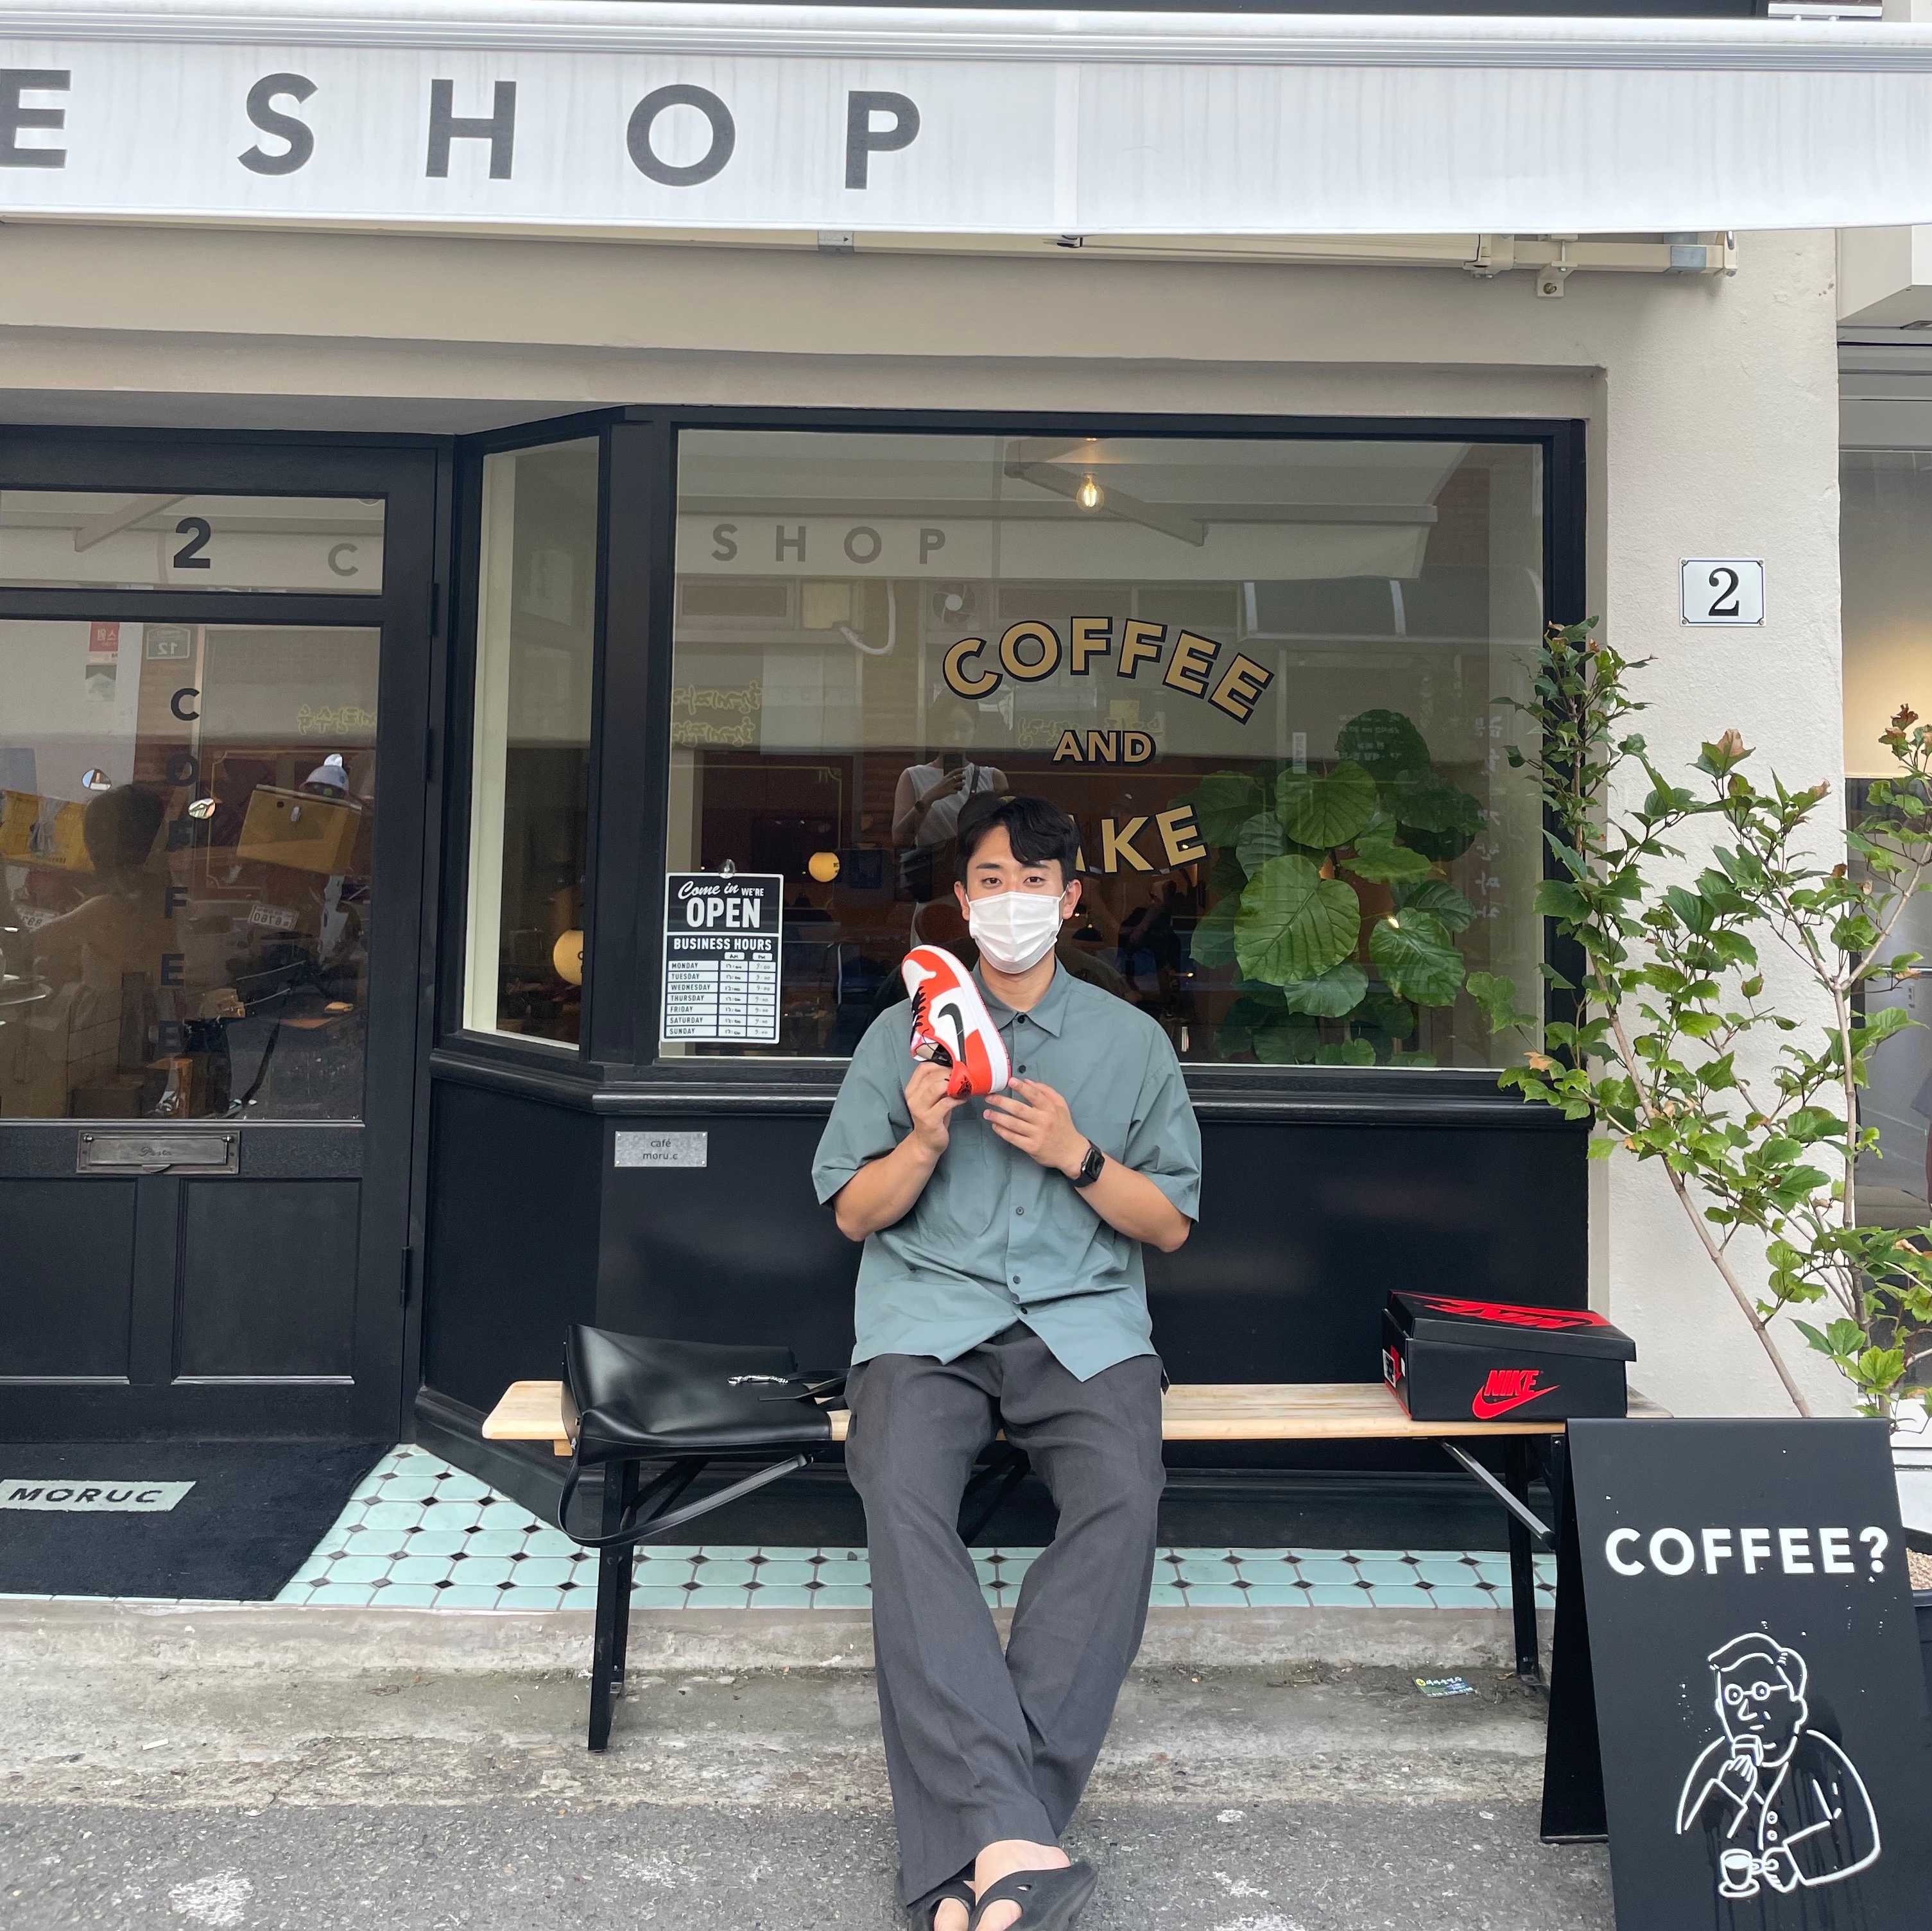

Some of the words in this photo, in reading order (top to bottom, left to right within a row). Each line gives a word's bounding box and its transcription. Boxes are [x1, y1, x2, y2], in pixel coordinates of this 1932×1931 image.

[237, 72, 920, 191] SHOP
[173, 517, 211, 569] 2
[711, 524, 945, 565] SHOP
[1708, 567, 1739, 617] 2
[942, 616, 1275, 725] COFFEE
[1049, 729, 1157, 766] AND
[1068, 802, 1211, 877] KE
[678, 880, 720, 899] Come
[723, 882, 739, 894] in
[741, 888, 764, 896] WE'RE
[687, 897, 761, 928] OPEN
[674, 938, 730, 950] BUSINESS
[734, 938, 772, 951] HOURS
[650, 1139, 671, 1147] café
[1484, 1369, 1540, 1396] NIKE
[8, 1487, 164, 1504] MORUC
[1605, 1527, 1889, 1576] COFFEE?
